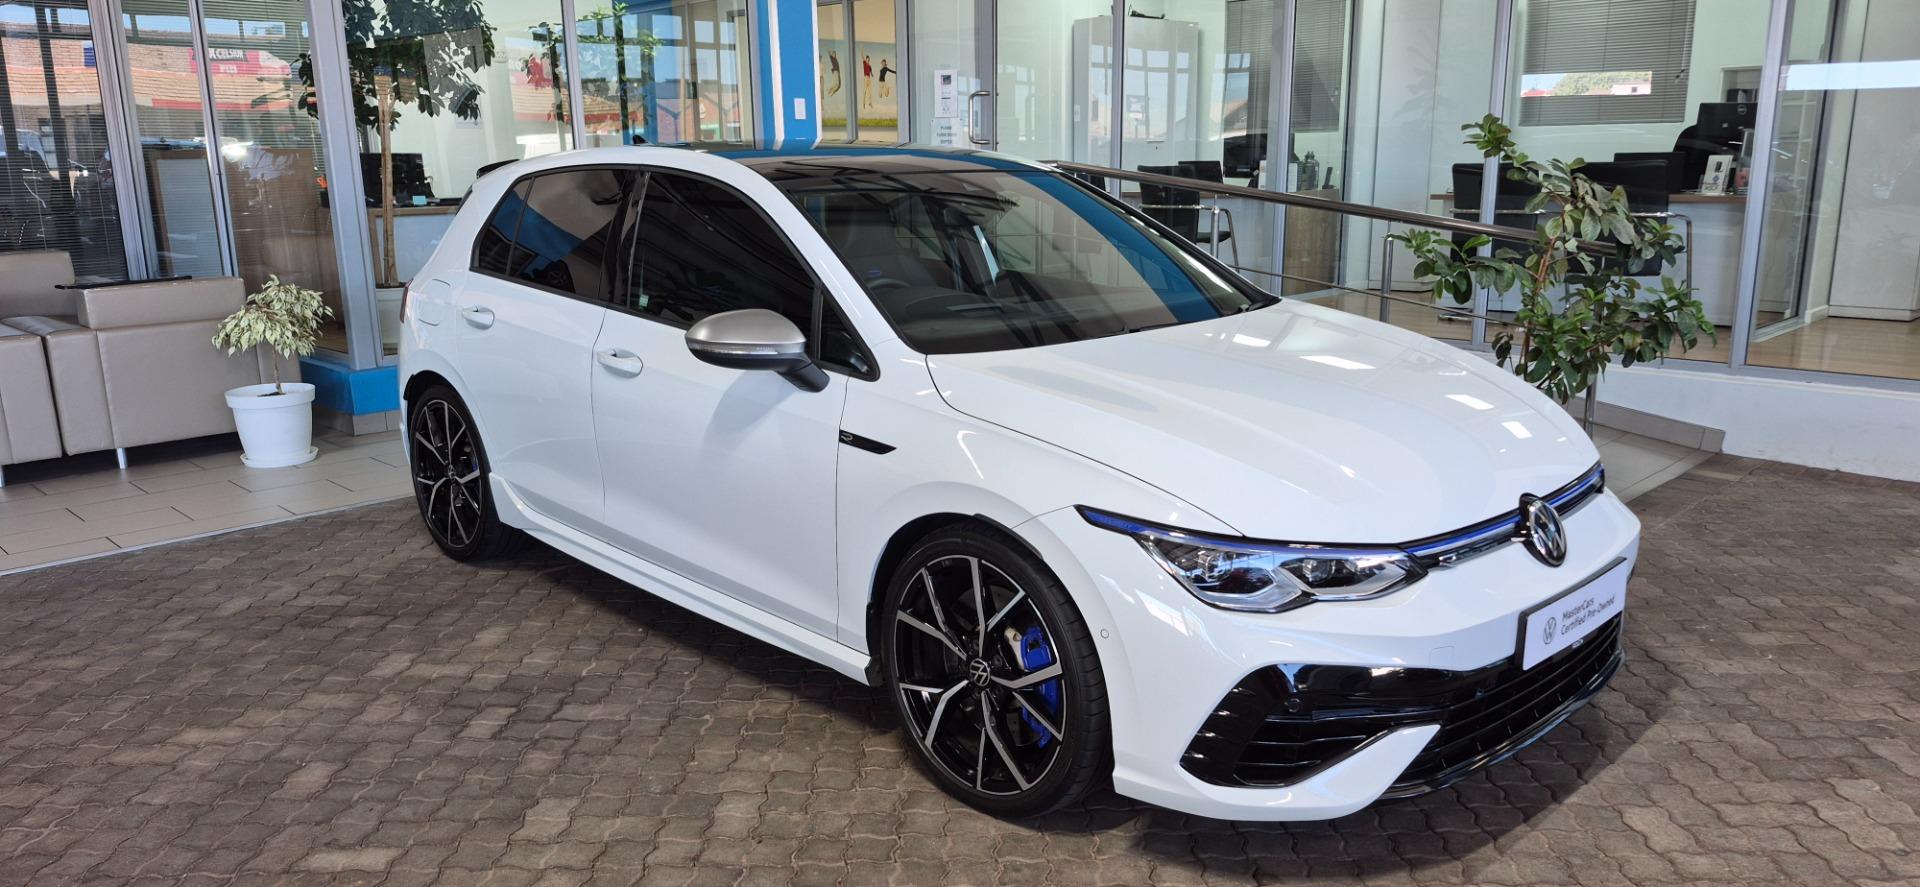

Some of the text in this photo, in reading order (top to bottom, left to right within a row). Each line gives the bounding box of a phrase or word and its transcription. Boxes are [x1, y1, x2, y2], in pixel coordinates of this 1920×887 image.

[1561, 594, 1615, 635] Certified Pre-Owned
[1562, 597, 1595, 620] MasterCars
